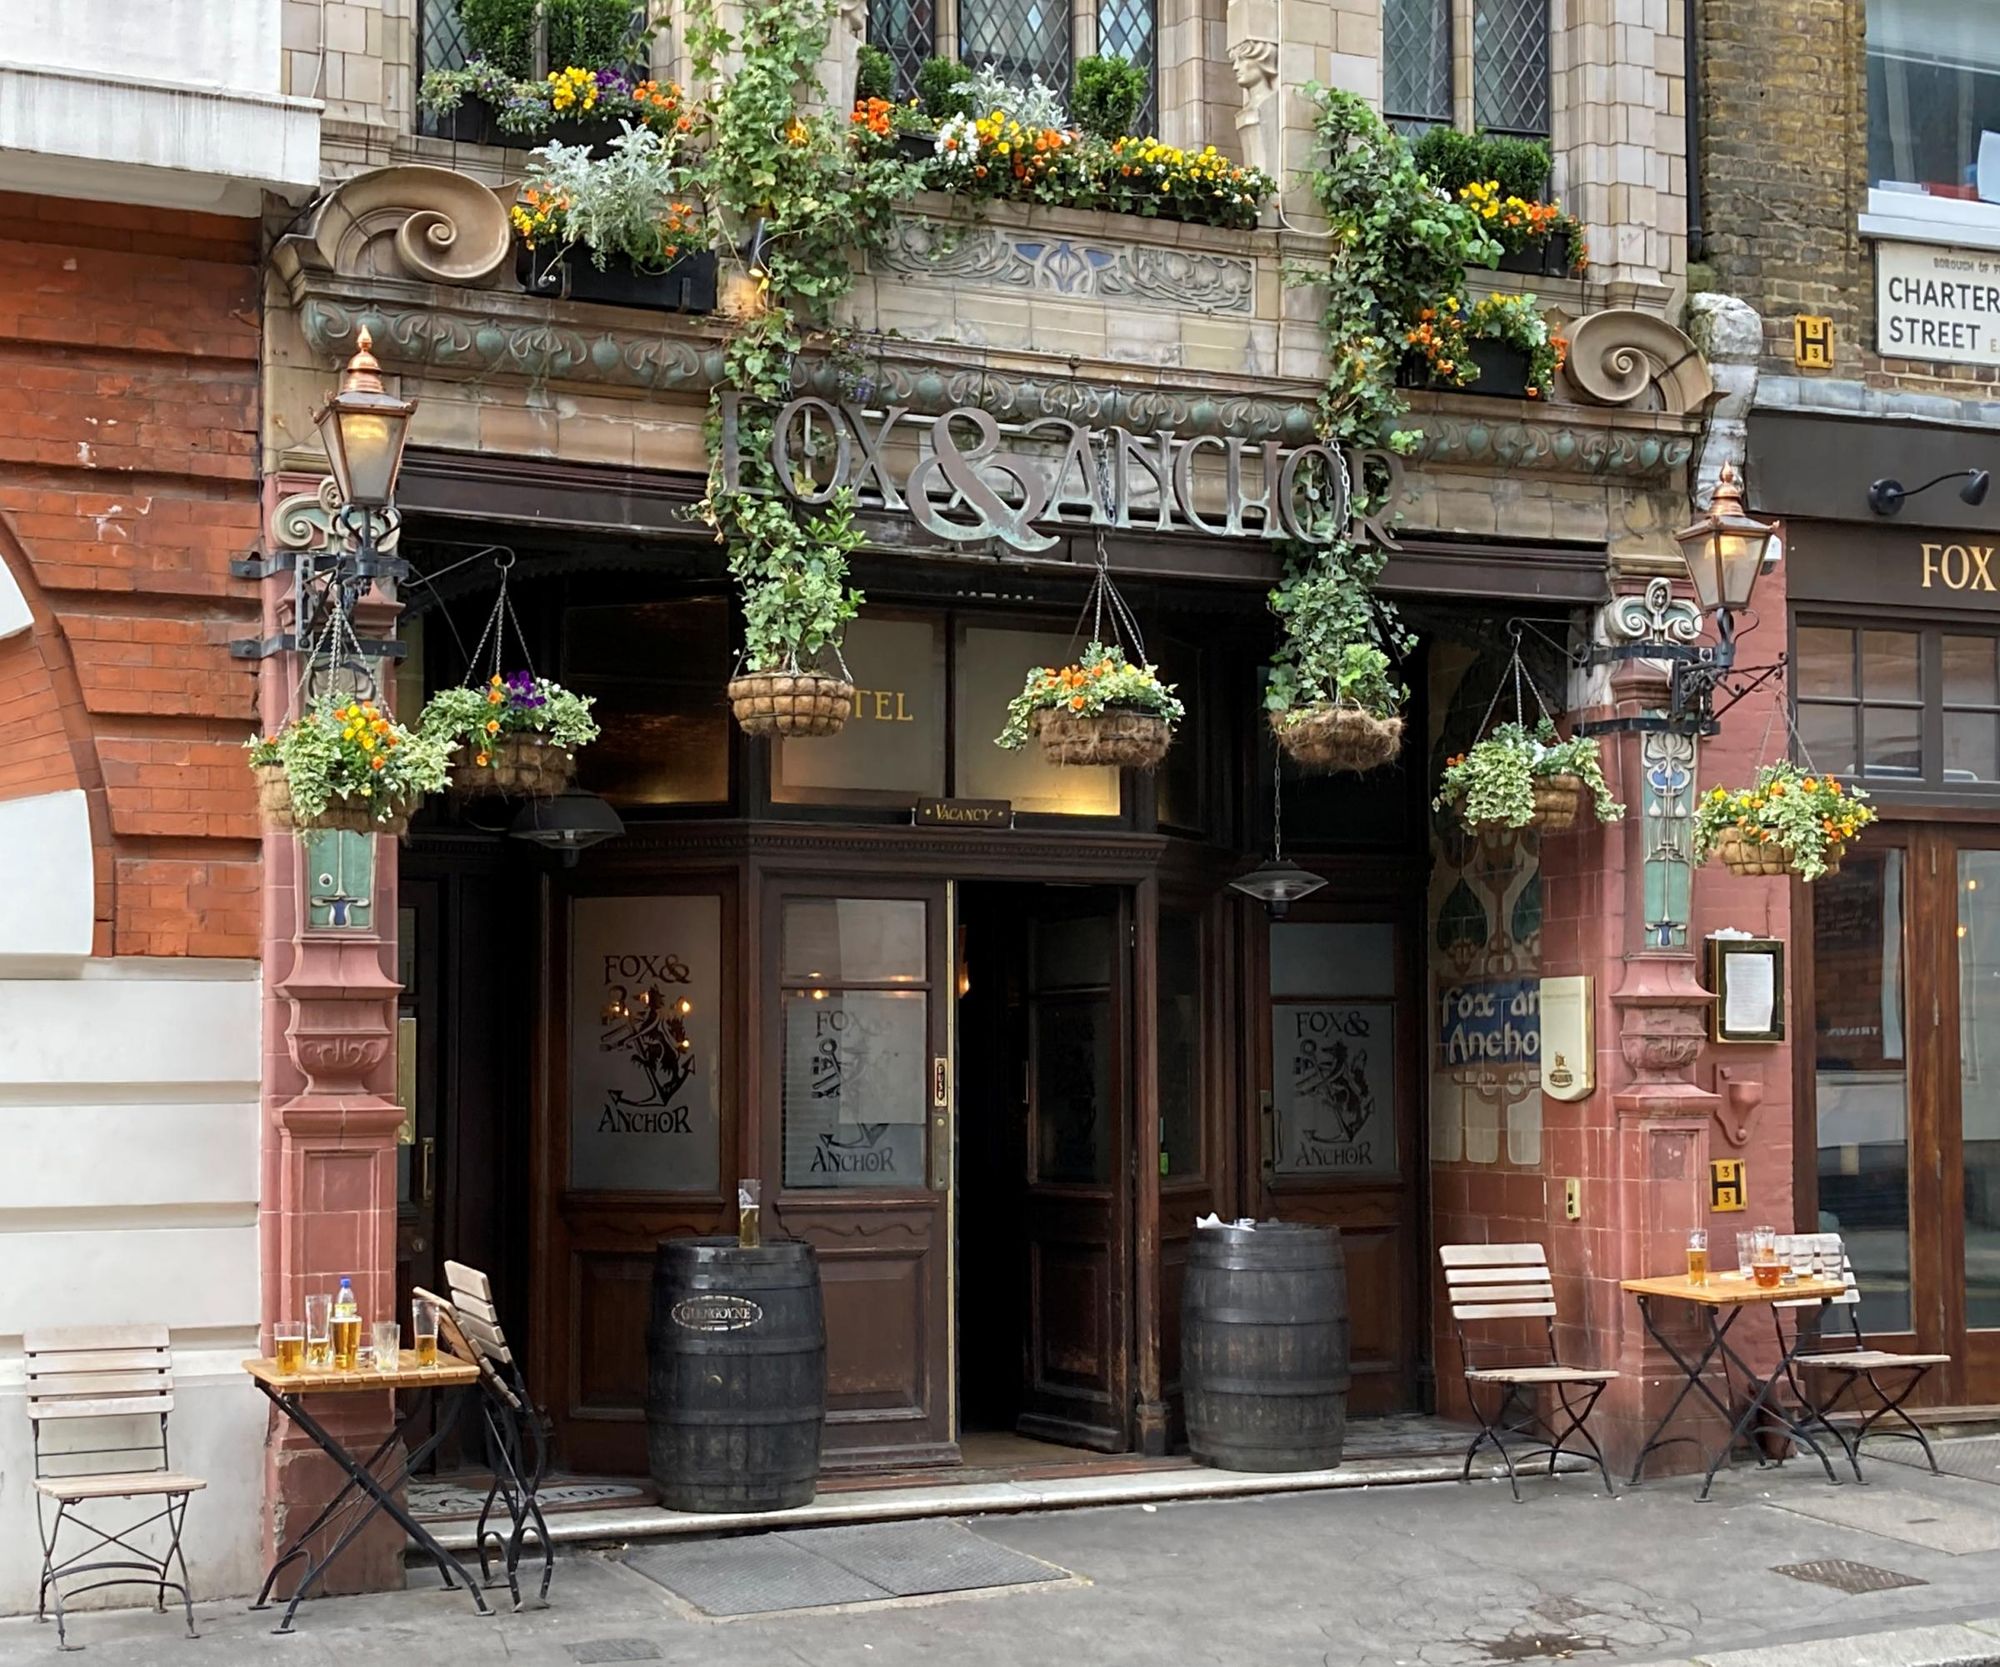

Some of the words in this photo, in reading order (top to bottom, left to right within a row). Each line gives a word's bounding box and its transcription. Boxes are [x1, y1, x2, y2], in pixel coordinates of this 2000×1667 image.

[1933, 257, 1974, 271] BOROUGH
[1888, 276, 2000, 313] CHARTER
[1800, 320, 1829, 362] H
[1811, 324, 1819, 335] 3
[1889, 315, 1981, 350] STREET
[1812, 347, 1819, 359] 3
[1920, 543, 1997, 591] FOX
[936, 804, 993, 821] VACANCY
[597, 1103, 693, 1133] ANCHOR
[810, 1146, 895, 1173] ANCHOR
[1295, 1141, 1372, 1167] ANCHOR
[1710, 1163, 1742, 1206] H
[1722, 1166, 1730, 1178] 3
[1723, 1191, 1731, 1203] 3
